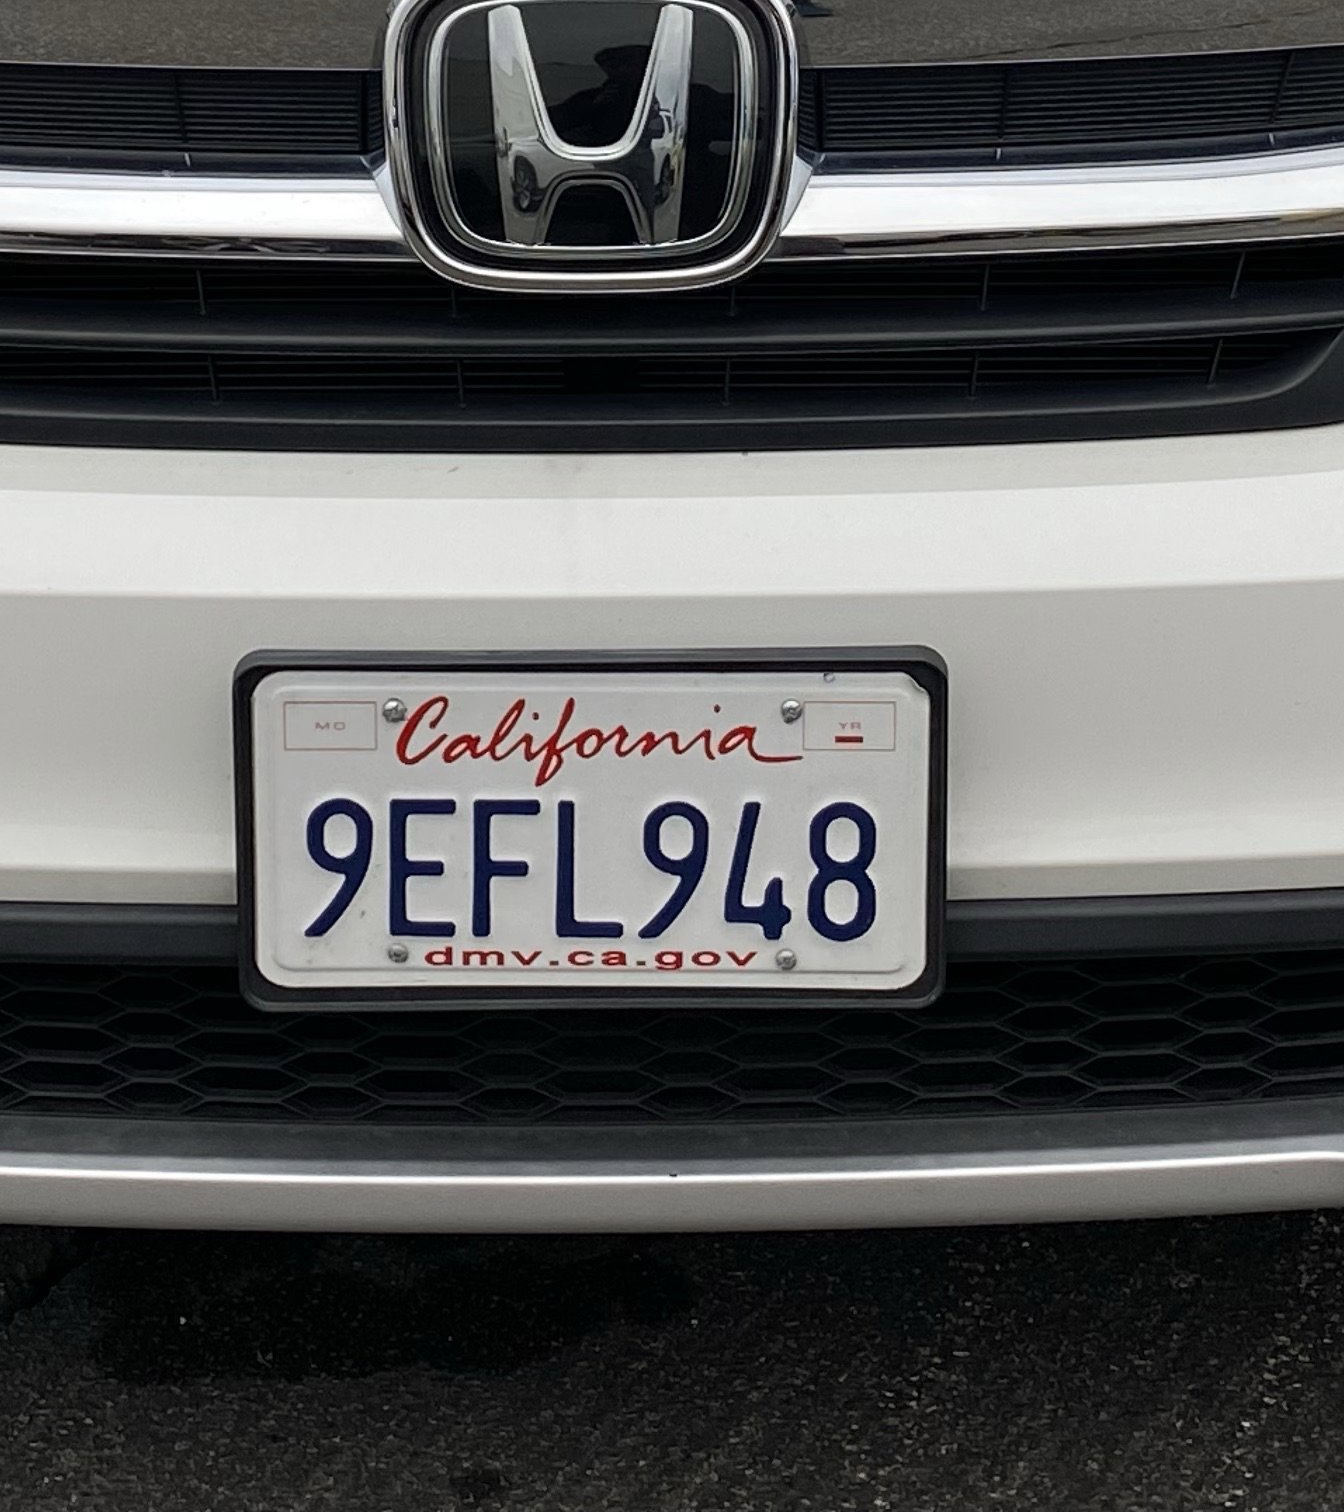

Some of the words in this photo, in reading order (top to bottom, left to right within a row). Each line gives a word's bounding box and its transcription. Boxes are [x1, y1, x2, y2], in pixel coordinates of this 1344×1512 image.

[315, 721, 346, 731] MO
[838, 721, 862, 730] YR
[396, 696, 803, 787] California
[304, 797, 877, 943] 9EFL948
[424, 946, 758, 971] dmv.ca.gov
